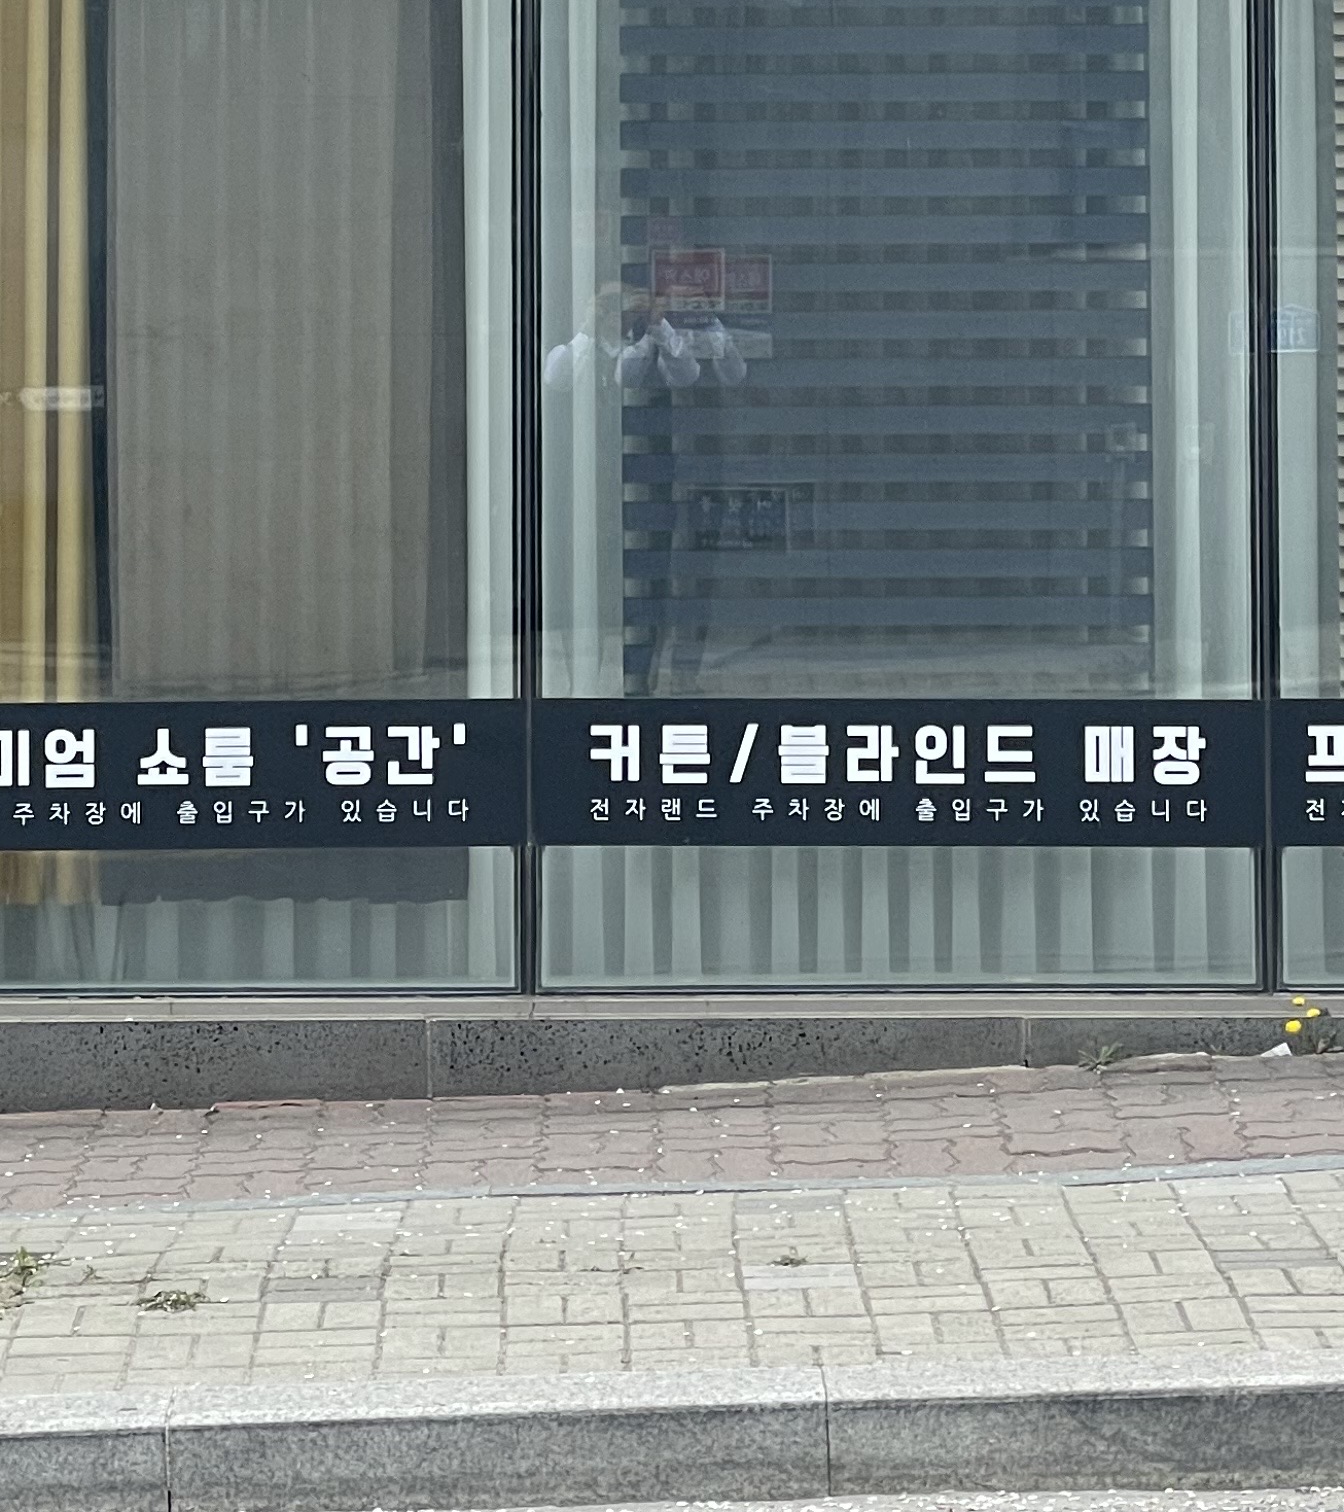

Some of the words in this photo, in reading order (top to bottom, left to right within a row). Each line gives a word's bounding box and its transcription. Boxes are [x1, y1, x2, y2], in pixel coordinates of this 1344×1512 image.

[137, 727, 254, 787] 쇼룸
[590, 723, 1036, 785] 커튼/블라인드
[1084, 725, 1207, 785] 매장
[12, 801, 141, 826] 주차장에
[176, 800, 306, 824] 출입구가
[341, 798, 469, 823] 있습니다
[590, 797, 718, 821] 전자랜드
[751, 798, 880, 822] 주차장에
[915, 798, 1045, 822] 출입구가
[1079, 798, 1208, 822] 있습니다
